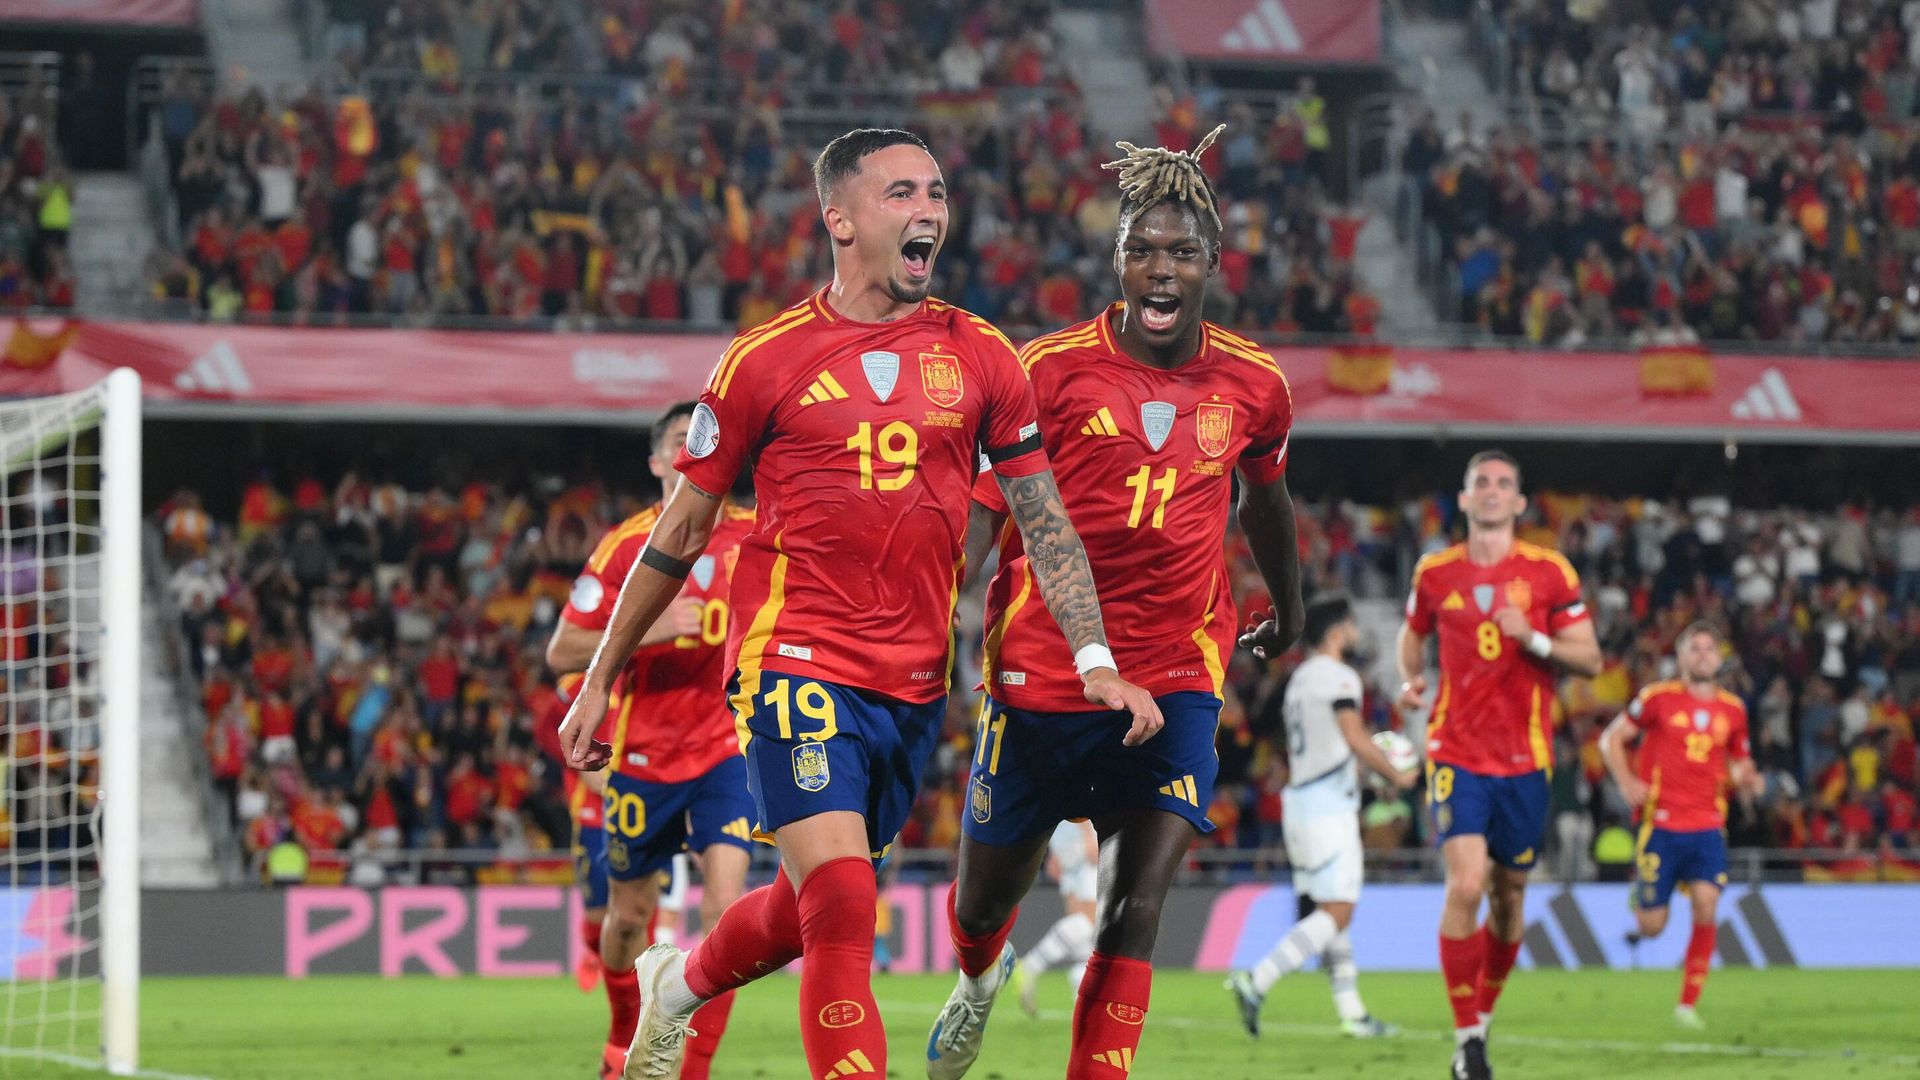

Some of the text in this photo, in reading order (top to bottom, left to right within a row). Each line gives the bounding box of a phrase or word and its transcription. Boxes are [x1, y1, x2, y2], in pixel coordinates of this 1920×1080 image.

[846, 421, 918, 490] 19
[1125, 464, 1177, 528] 11
[1475, 620, 1502, 661] 8
[764, 678, 838, 741] 19
[977, 703, 1007, 776] 11
[604, 786, 646, 838] 20
